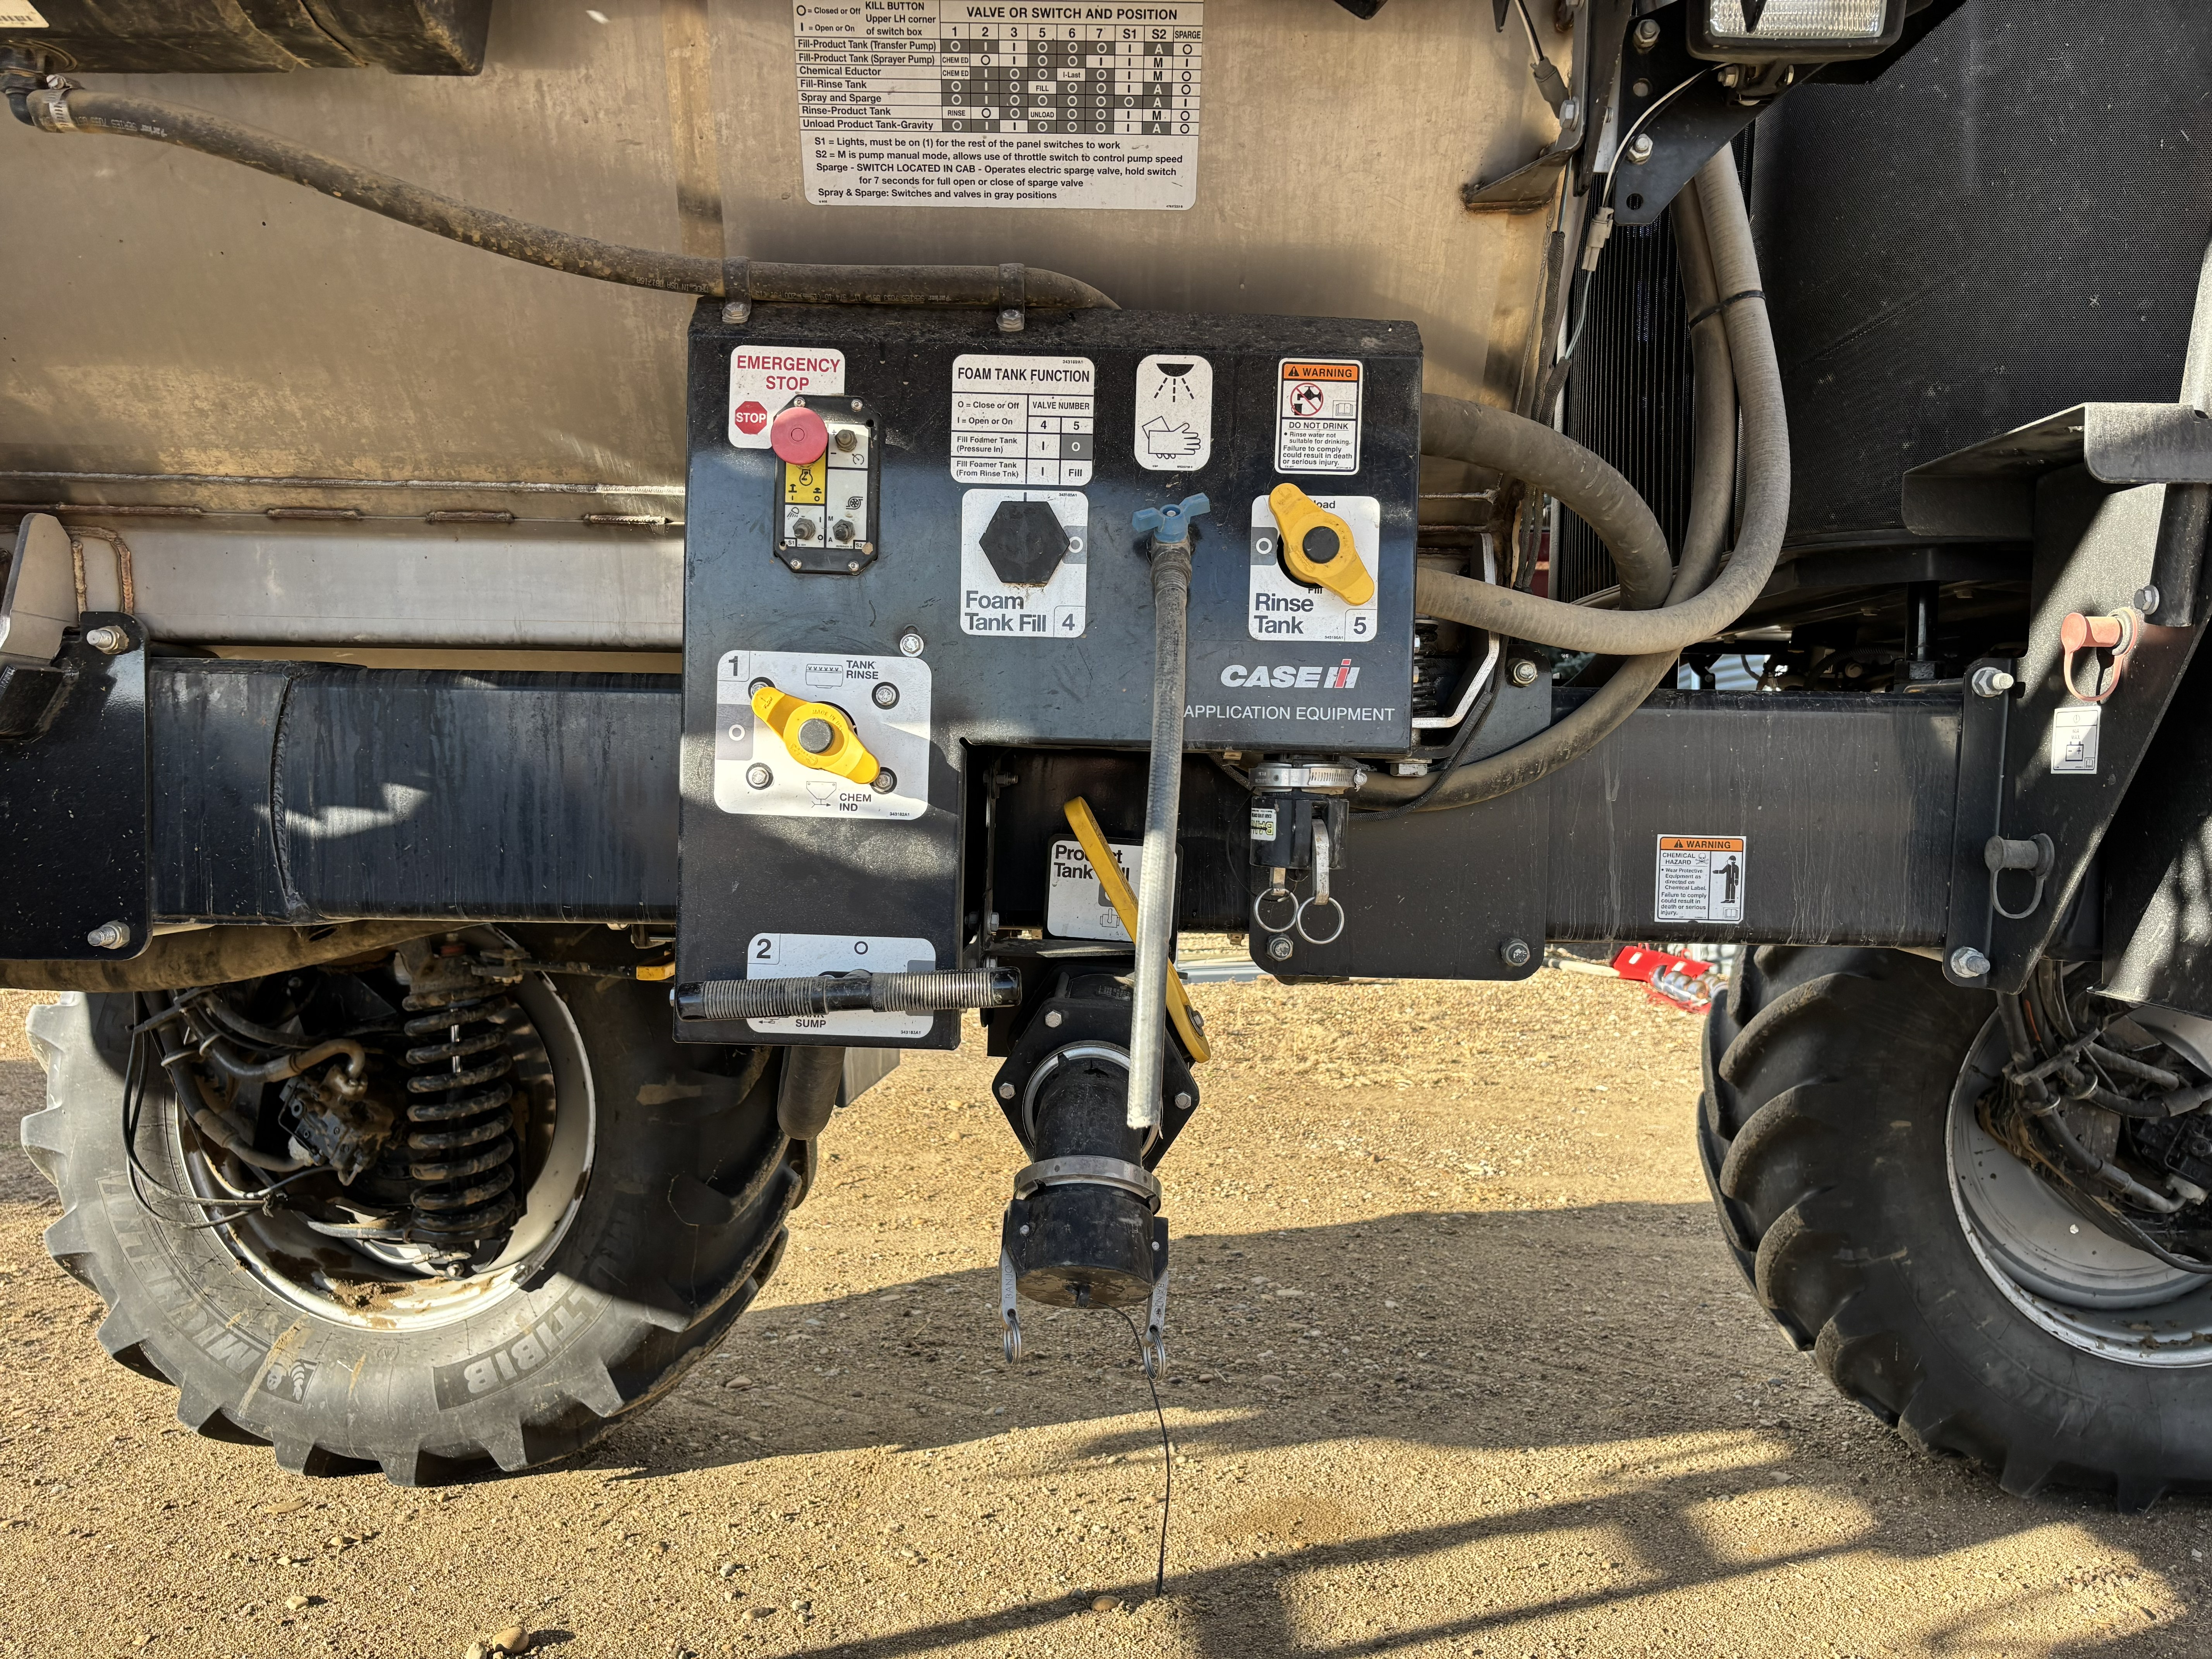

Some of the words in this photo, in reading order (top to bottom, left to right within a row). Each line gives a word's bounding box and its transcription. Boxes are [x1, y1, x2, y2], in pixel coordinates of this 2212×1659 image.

[865, 1, 884, 10] KILL
[887, 1, 924, 10] BUTTON
[866, 13, 891, 24] Upper
[894, 14, 905, 23] LH
[966, 6, 1005, 17] VALVE
[1009, 7, 1027, 18] OR
[1031, 7, 1081, 19] SWITCH
[1085, 8, 1113, 19] AND
[1117, 8, 1177, 20] POSITION
[866, 26, 874, 35] of
[876, 27, 904, 35] switch
[907, 27, 922, 36] box
[951, 26, 957, 37] 1
[981, 26, 989, 37] 2
[1010, 27, 1018, 38] 3
[1039, 27, 1046, 38] 5
[1068, 27, 1075, 38] 6
[1096, 28, 1103, 38] 7
[1122, 28, 1136, 39] S1
[1151, 28, 1166, 39] S2
[1175, 30, 1201, 39] SPARGE
[798, 39, 846, 48] Fill-Product
[848, 40, 868, 49] Tank
[870, 40, 907, 50] (Transfer
[909, 41, 936, 51] Pump)
[799, 53, 847, 62] Fill-Product
[848, 53, 869, 63] Tank
[871, 54, 906, 64] (Sprayer
[908, 54, 934, 65] Pump)
[799, 65, 842, 75] Chemical
[845, 66, 881, 76] Eductor
[800, 79, 843, 88] Fill-Rinse
[844, 79, 867, 89] Tank
[801, 92, 827, 103] Spray
[830, 93, 847, 101] and
[849, 93, 881, 104] Sparge
[802, 105, 867, 115] Rinse-Product
[869, 106, 891, 115] Tank
[803, 118, 835, 127] Unload
[837, 119, 873, 128] Product
[875, 120, 933, 131] Tank-Gravity
[818, 188, 843, 198] Spray
[855, 188, 889, 198] Sparge:
[891, 189, 932, 197] Switches
[934, 189, 951, 198] and
[953, 190, 981, 198] valves
[984, 190, 992, 198] in
[994, 192, 1014, 200] gray
[1016, 191, 1057, 200] positions
[666, 282, 679, 290] USA
[682, 283, 689, 292] IN
[737, 355, 840, 373] EMERGENCY
[958, 367, 991, 380] FOAM
[994, 368, 1027, 381] TANK
[1030, 369, 1089, 382] FUNCTION
[1302, 367, 1352, 378] WARNING
[765, 375, 809, 391] STOP
[1032, 401, 1056, 409] VALVE
[1058, 402, 1089, 410] NUMBER
[736, 412, 766, 423] STOP
[1040, 420, 1047, 429] 4
[1073, 421, 1080, 430] 5
[957, 445, 992, 454] (Pressure
[993, 445, 1003, 454] In)
[1319, 459, 1339, 467] injury.
[956, 469, 977, 477] (From
[1002, 470, 1018, 479] Tnk)
[1068, 468, 1082, 477] Fill
[965, 590, 1024, 610] Foam
[1255, 592, 1314, 612] Rinse
[964, 612, 1014, 631] Tank
[1019, 613, 1046, 632] Fill
[1061, 613, 1075, 631] 4
[1253, 615, 1304, 634] Tank
[1353, 616, 1367, 634] 5
[728, 655, 738, 676] 1
[846, 659, 876, 670] TANK
[846, 670, 879, 680] RINSE
[1220, 664, 1323, 688] CASE
[1183, 704, 1290, 720] APPLICATION
[1296, 706, 1395, 721] EQUIPMENT
[839, 793, 871, 802] CHEM
[839, 802, 858, 811] IND
[1686, 840, 1731, 849] WARNING
[1053, 862, 1094, 879] Tank
[756, 938, 771, 959] 2
[795, 1017, 826, 1028] SUMP
[1005, 1265, 1013, 1298] BANJO
